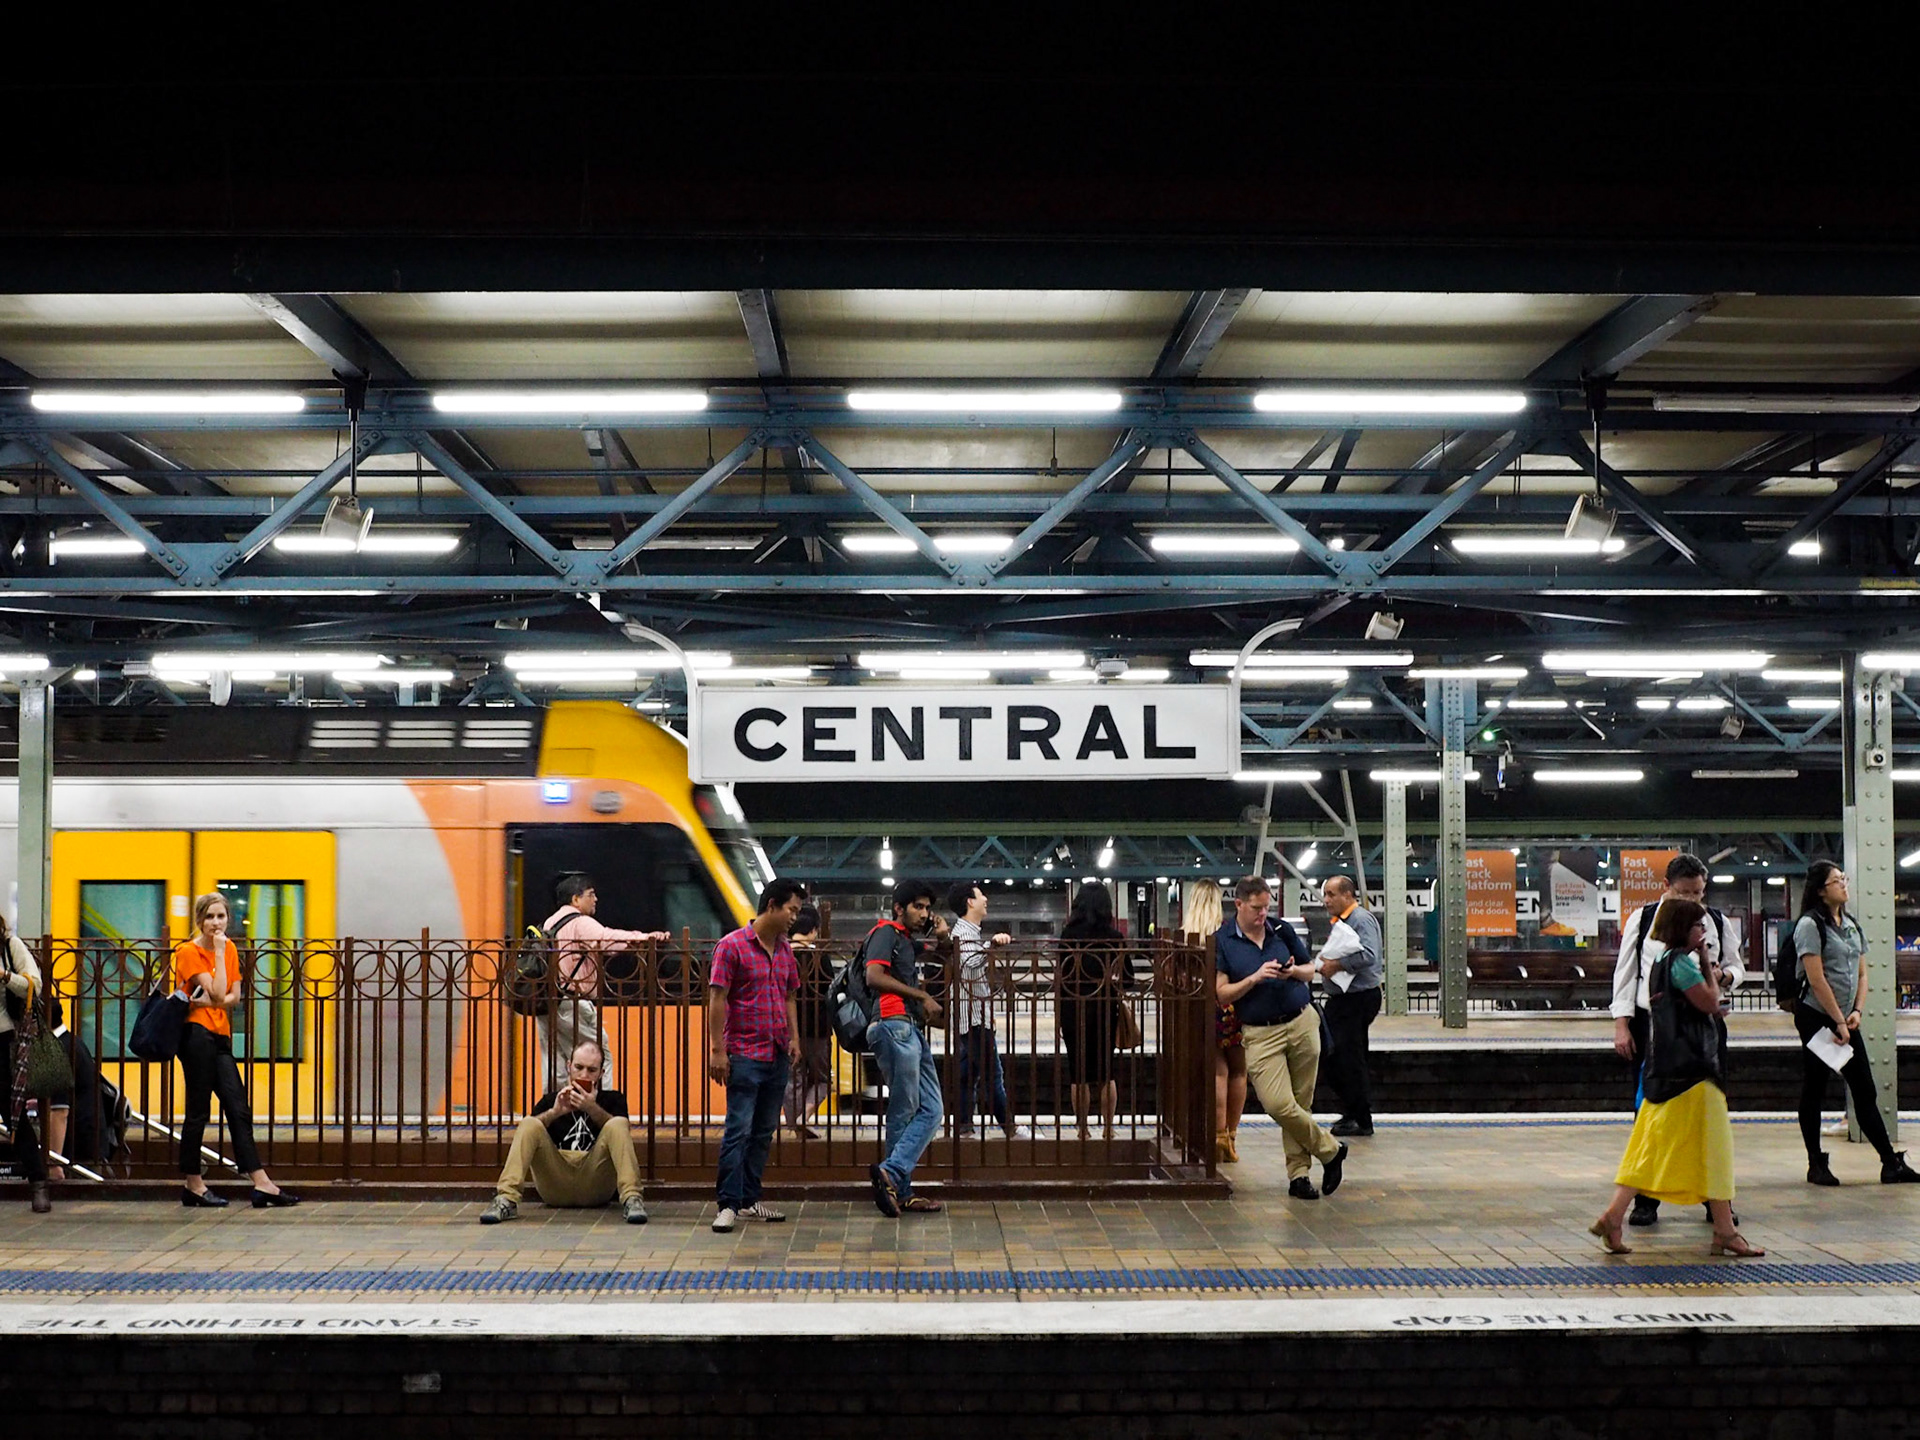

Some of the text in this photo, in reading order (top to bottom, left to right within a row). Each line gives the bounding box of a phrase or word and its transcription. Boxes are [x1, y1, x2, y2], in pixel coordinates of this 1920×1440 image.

[733, 705, 1197, 762] CENTRAL
[1466, 857, 1484, 868] ast
[1624, 857, 1647, 867] Fast
[1466, 868, 1491, 879] rack
[1624, 868, 1654, 879] Track
[1466, 879, 1512, 890] latform
[1624, 880, 1666, 890] Platfor
[1485, 899, 1504, 907] clear
[1471, 906, 1485, 915] the
[1486, 906, 1511, 915] doors.
[18, 1318, 482, 1329] STAND BEHIND THE
[1391, 1313, 1735, 1325] MIND THE GAP
